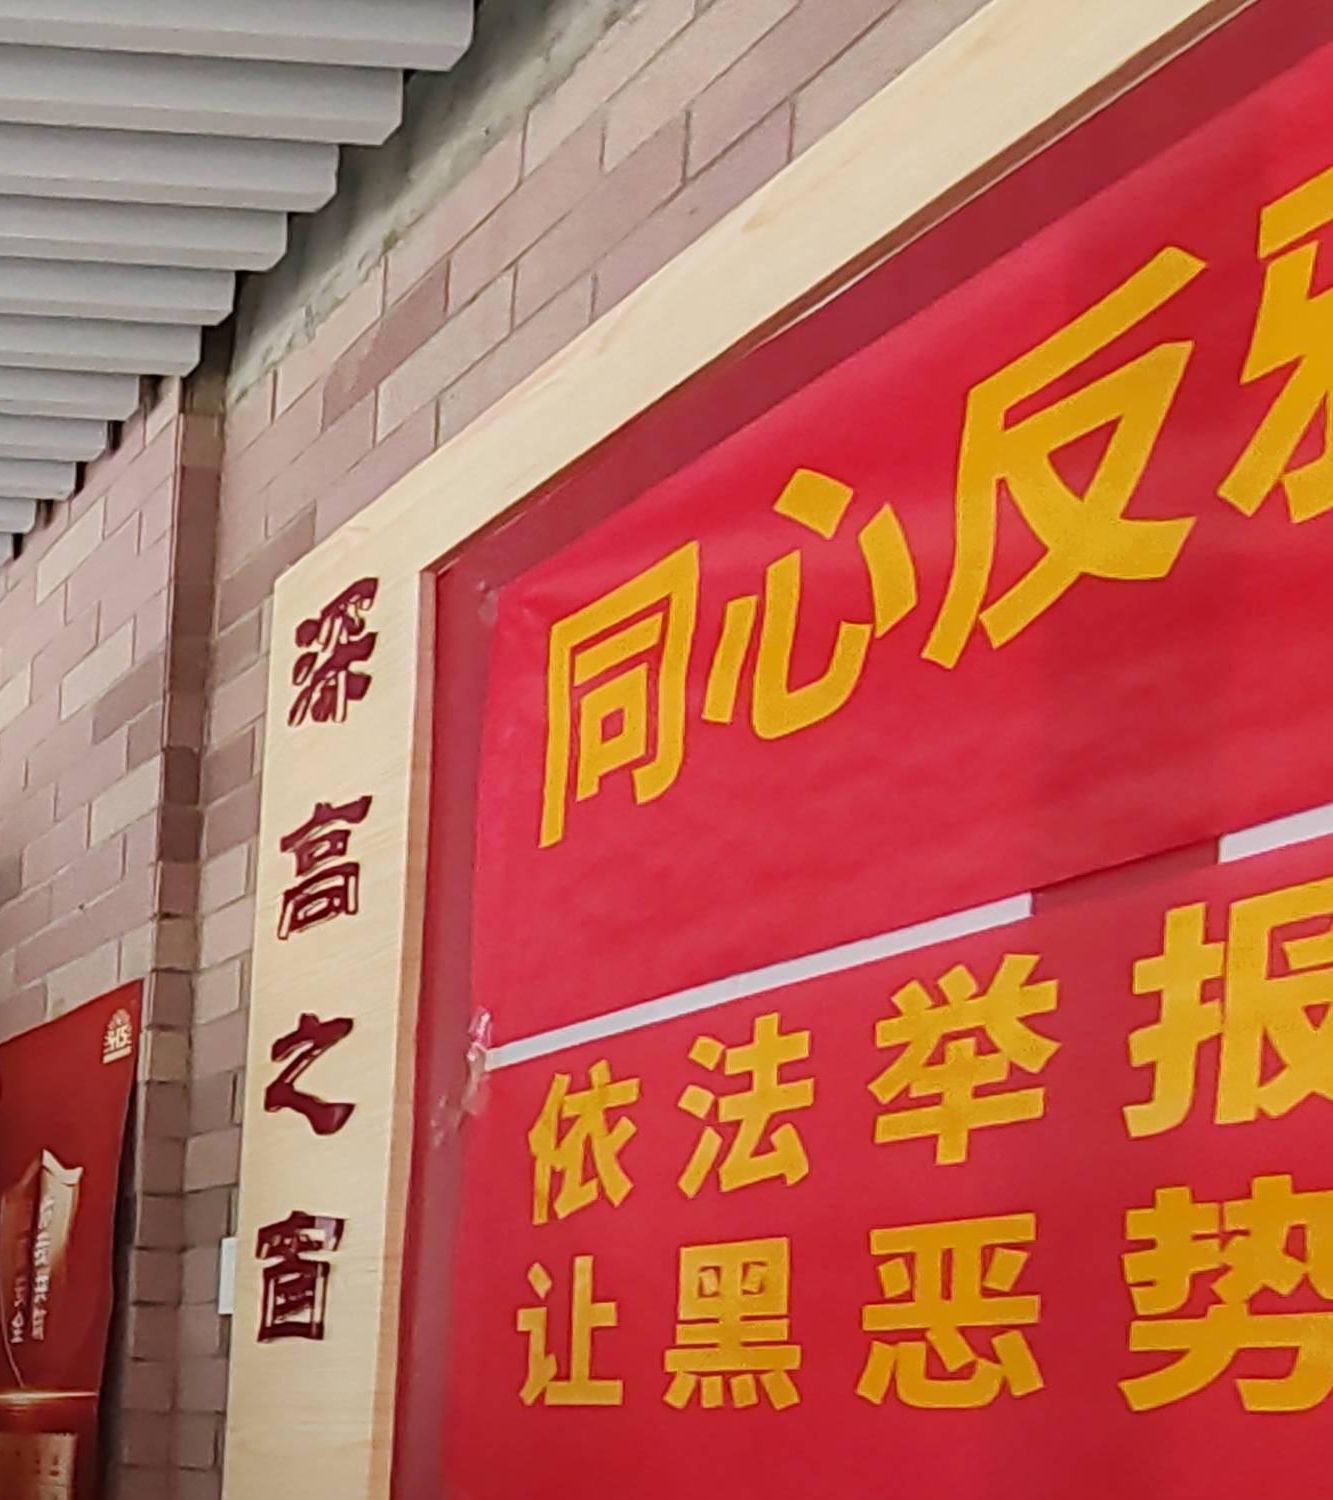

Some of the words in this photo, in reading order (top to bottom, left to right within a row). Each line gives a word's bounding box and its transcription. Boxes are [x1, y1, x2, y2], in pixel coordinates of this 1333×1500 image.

[254, 575, 380, 1345] 深高之窗
[527, 876, 1333, 1226] 依法举报
[515, 1174, 1333, 1413] 让黑恶势
